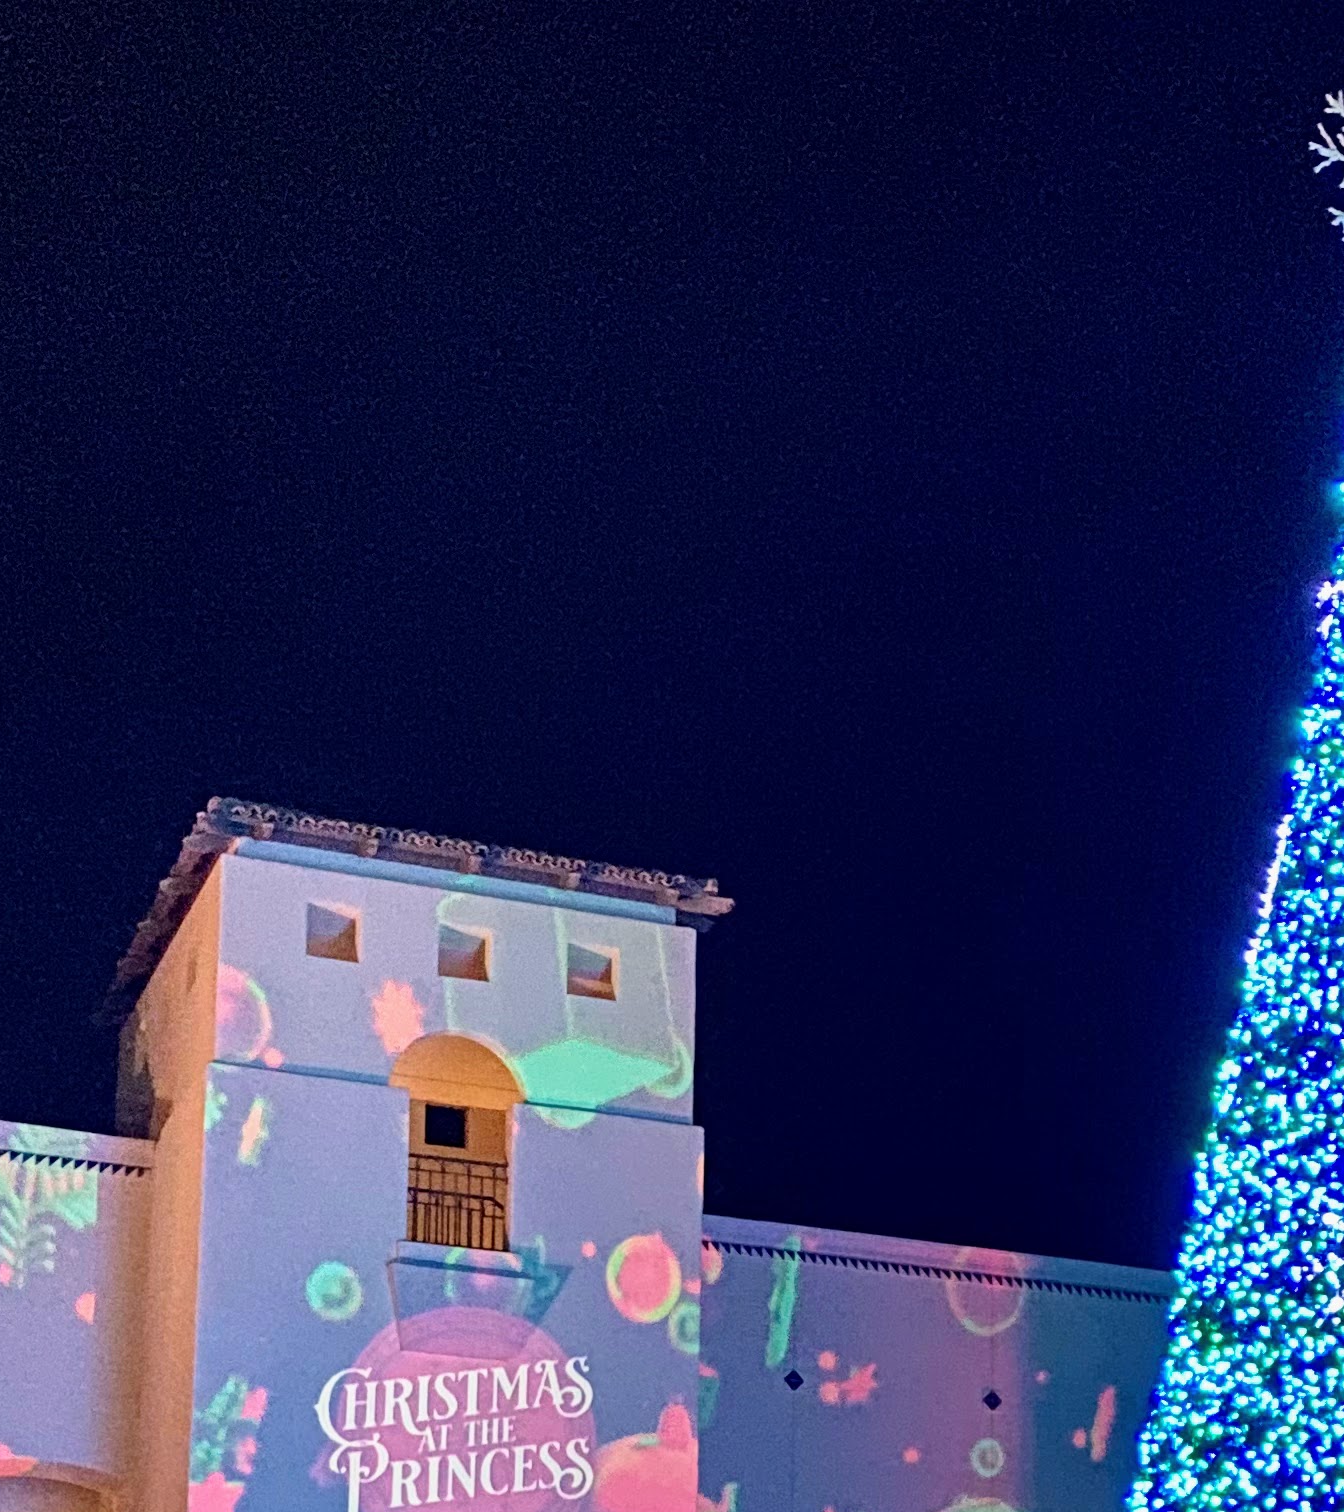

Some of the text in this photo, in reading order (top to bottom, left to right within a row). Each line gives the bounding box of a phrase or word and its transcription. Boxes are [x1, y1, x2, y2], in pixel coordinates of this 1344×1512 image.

[314, 1356, 594, 1446] CHRISTMAS
[418, 1415, 516, 1453] AT THE
